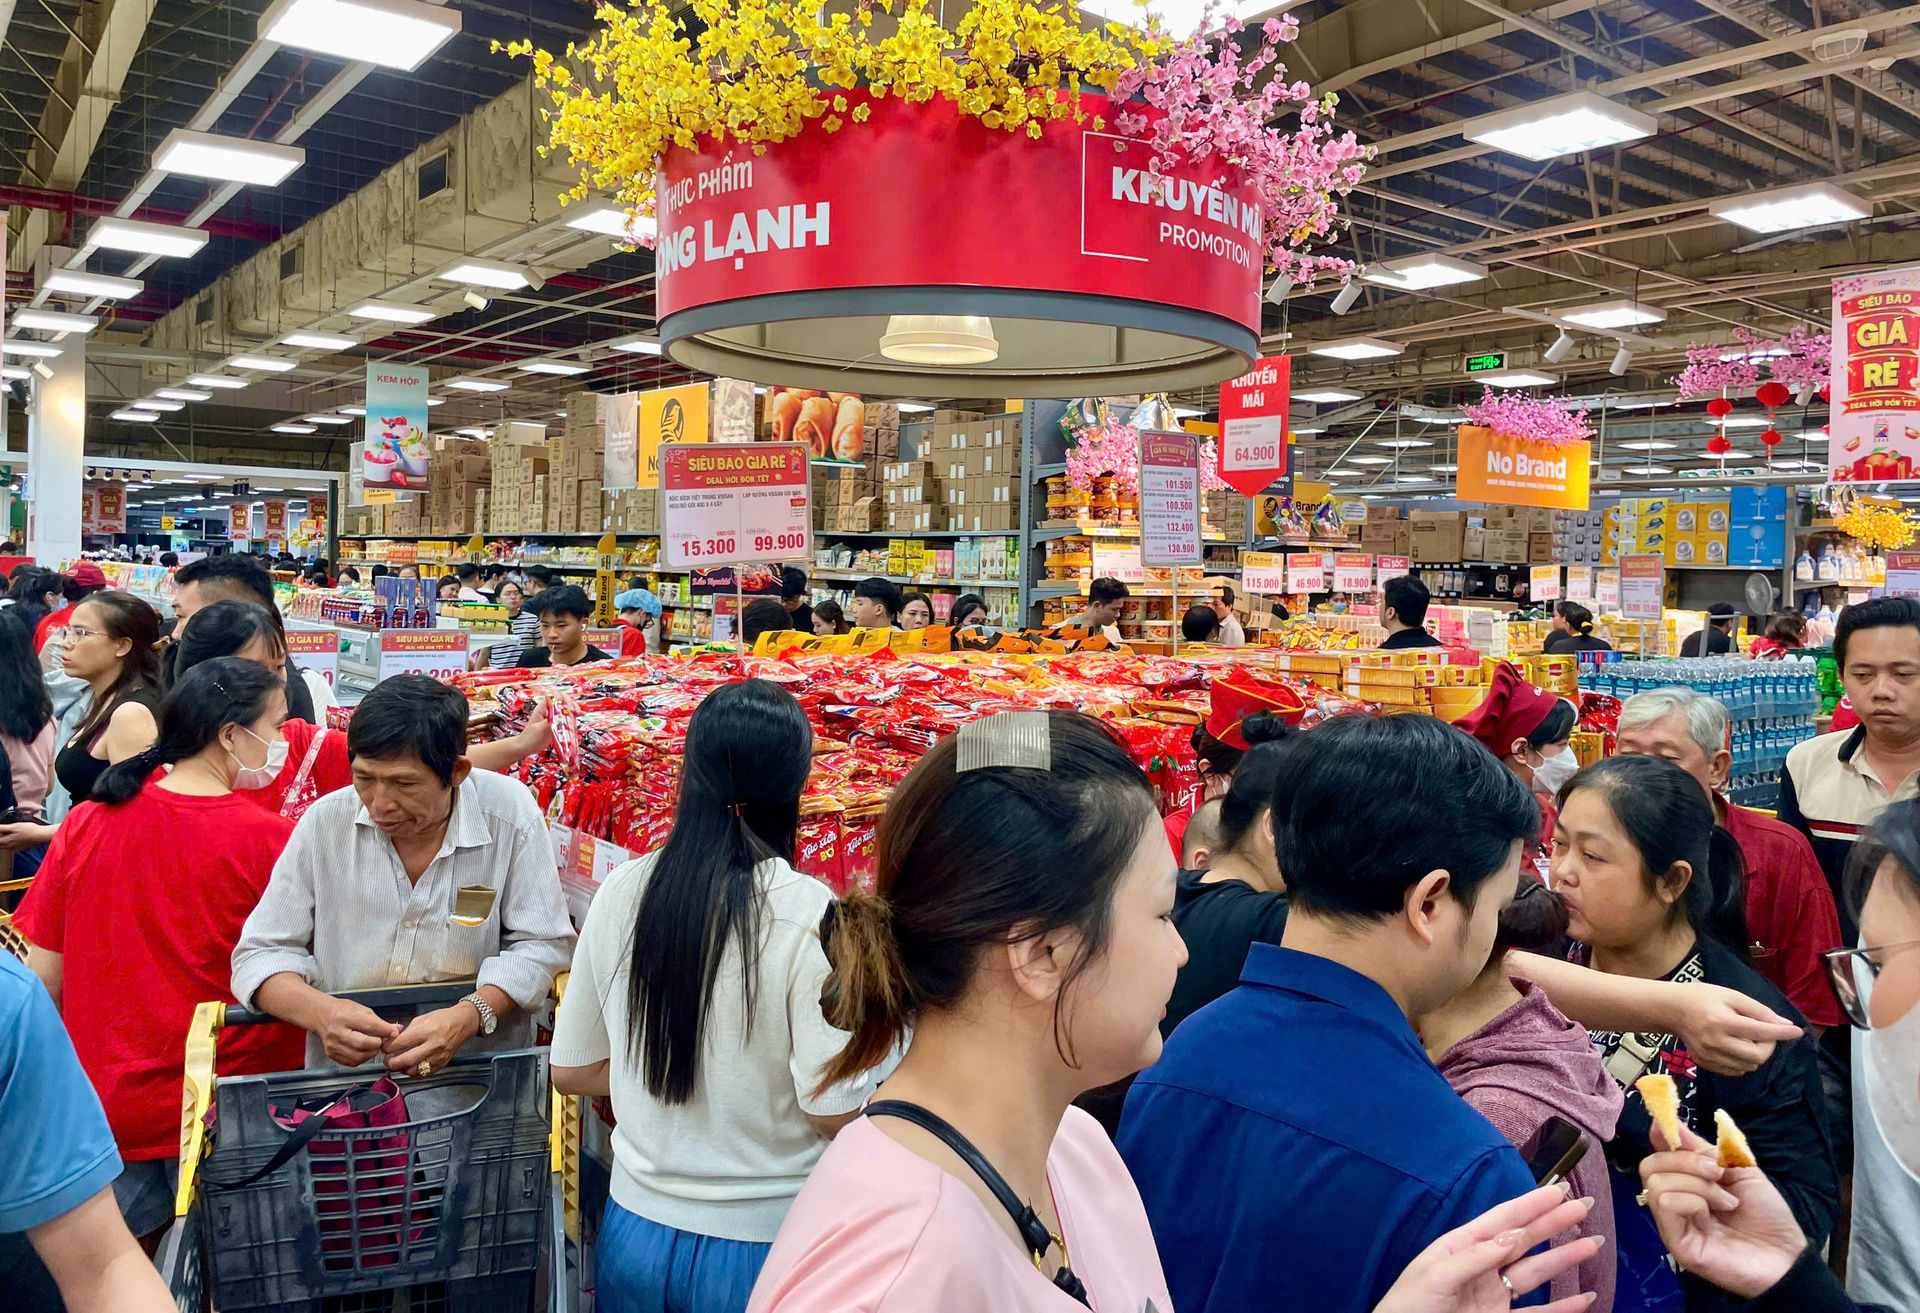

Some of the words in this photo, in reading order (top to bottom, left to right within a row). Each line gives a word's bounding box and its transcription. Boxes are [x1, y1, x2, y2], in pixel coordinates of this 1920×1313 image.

[664, 175, 696, 215] THỰC
[1112, 166, 1238, 229] KHUYẾN
[704, 202, 831, 271] LẠNH
[1159, 222, 1251, 269] PROMOTION
[1857, 295, 1883, 310] SIÊU
[1885, 291, 1912, 305] BÃO
[1856, 315, 1909, 348] GIÁ
[376, 374, 398, 384] KEM
[1231, 363, 1278, 388] KHUYẾN
[1863, 356, 1901, 389] RẺ
[1242, 389, 1265, 409] MÃI
[688, 455, 715, 471] SIÊU
[717, 454, 744, 470] BÃO
[746, 453, 770, 470] GIÁ
[770, 453, 787, 469] RẺ
[1234, 445, 1275, 462] 64.900
[1486, 450, 1513, 474] No
[1515, 453, 1567, 480] Brand
[706, 475, 724, 485] DEAL
[1165, 479, 1193, 490] 101.500
[1166, 500, 1193, 511] 100.500
[1166, 522, 1194, 532] 132.400
[682, 538, 736, 557] 15.300
[754, 533, 805, 551] 99.900
[1168, 543, 1195, 553] 130.900
[600, 575, 608, 601] Brand
[1246, 577, 1280, 589] 115.000
[1295, 577, 1321, 589] 46.900
[1343, 577, 1369, 588] 18.900
[600, 602, 607, 616] No
